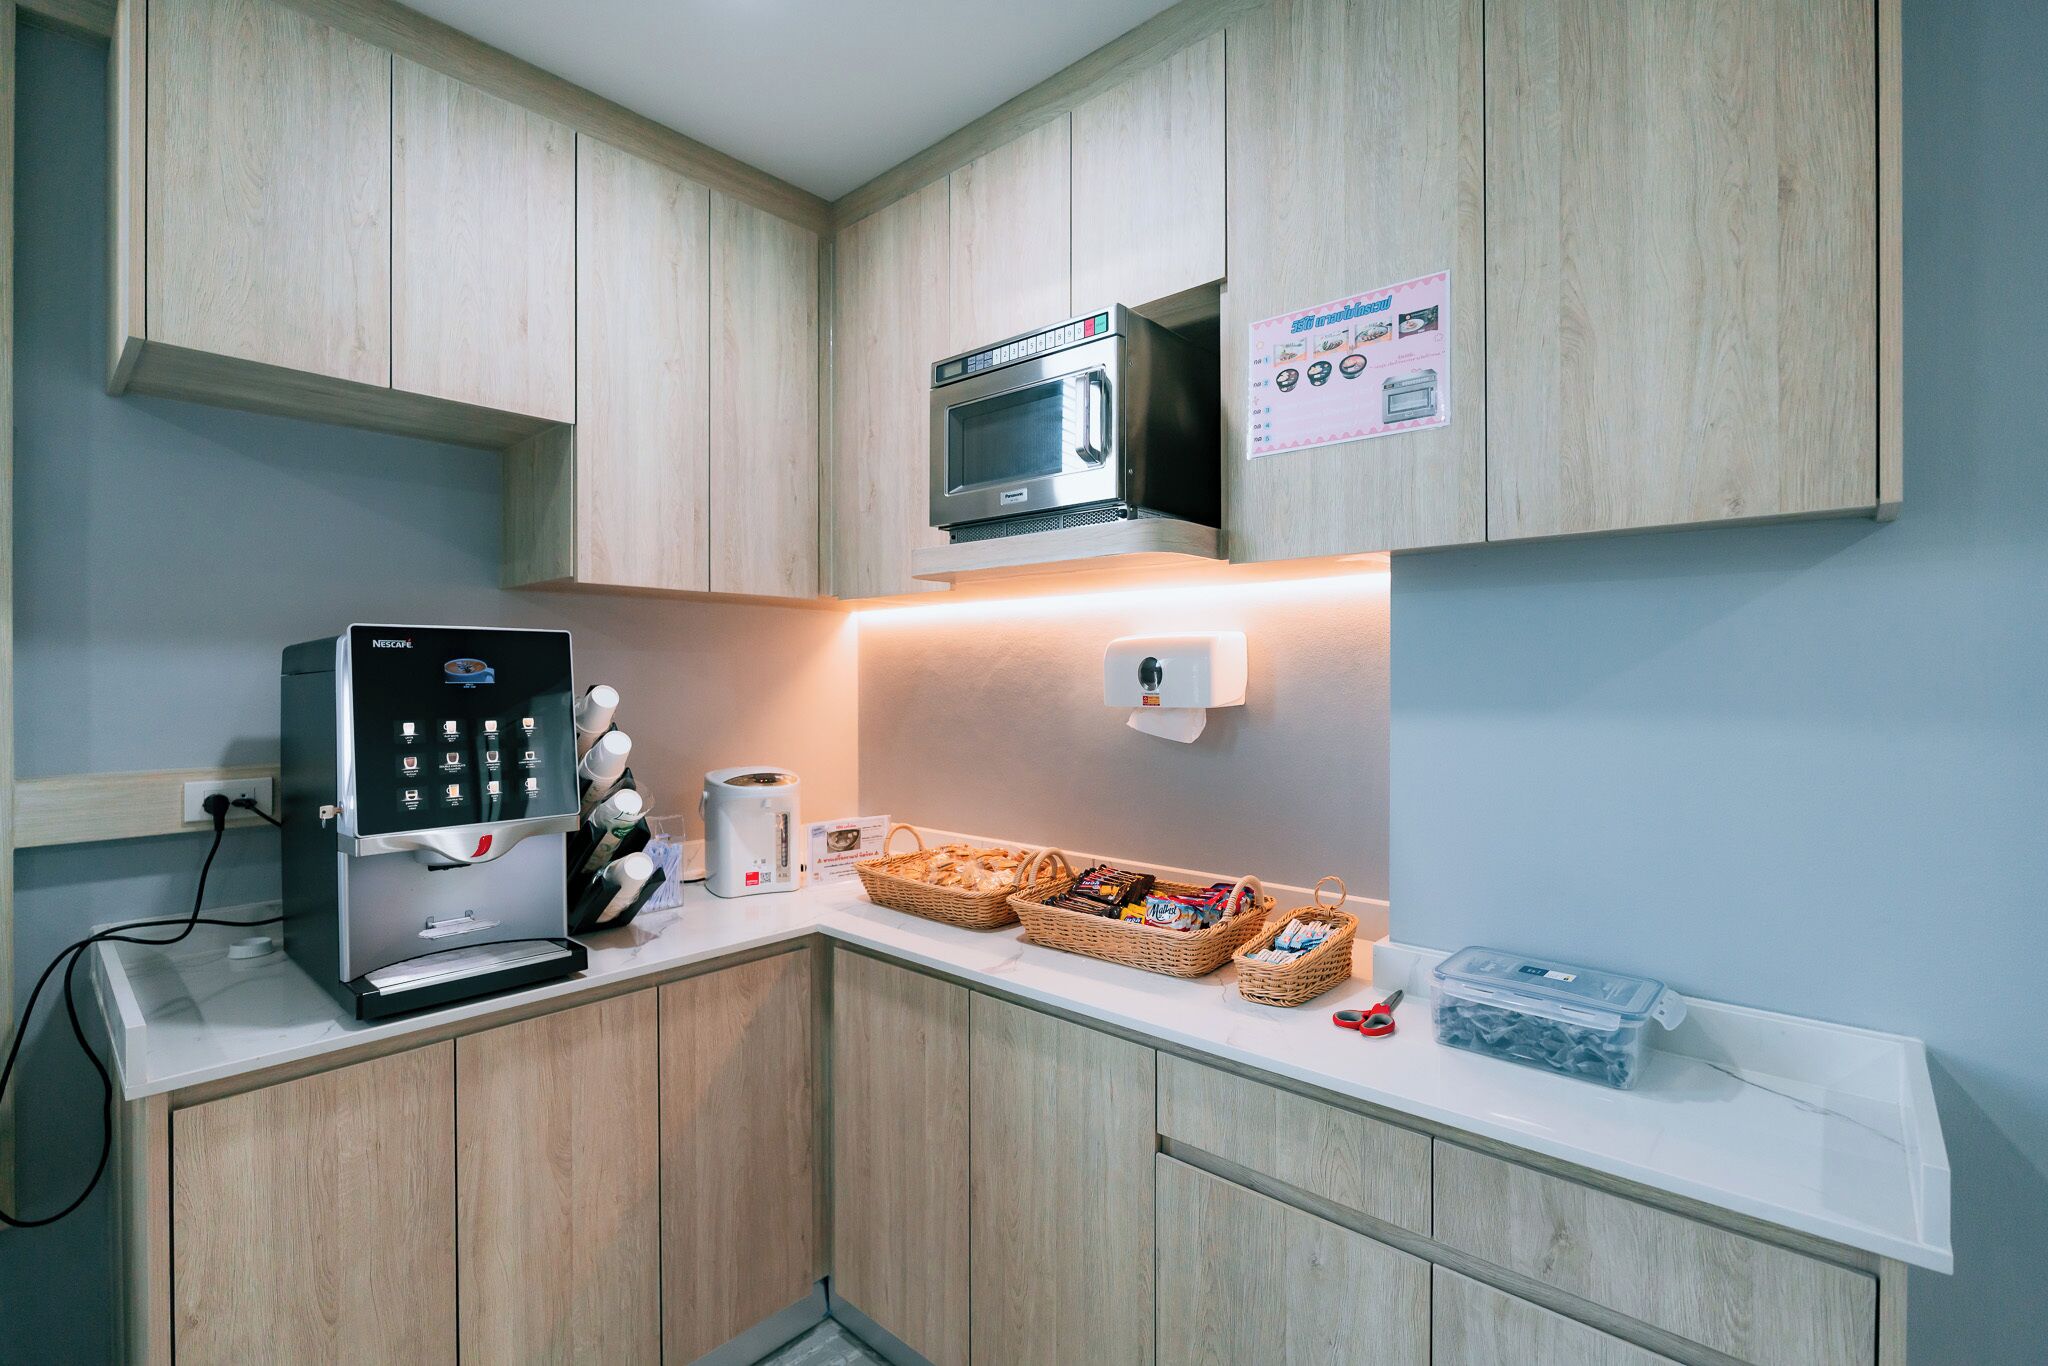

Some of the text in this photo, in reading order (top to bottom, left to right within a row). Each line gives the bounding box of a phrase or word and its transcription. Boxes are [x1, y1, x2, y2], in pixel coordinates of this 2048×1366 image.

[1315, 295, 1392, 327] เตาอบไมโครเวฟ
[372, 638, 412, 648] NESCAFÉ
